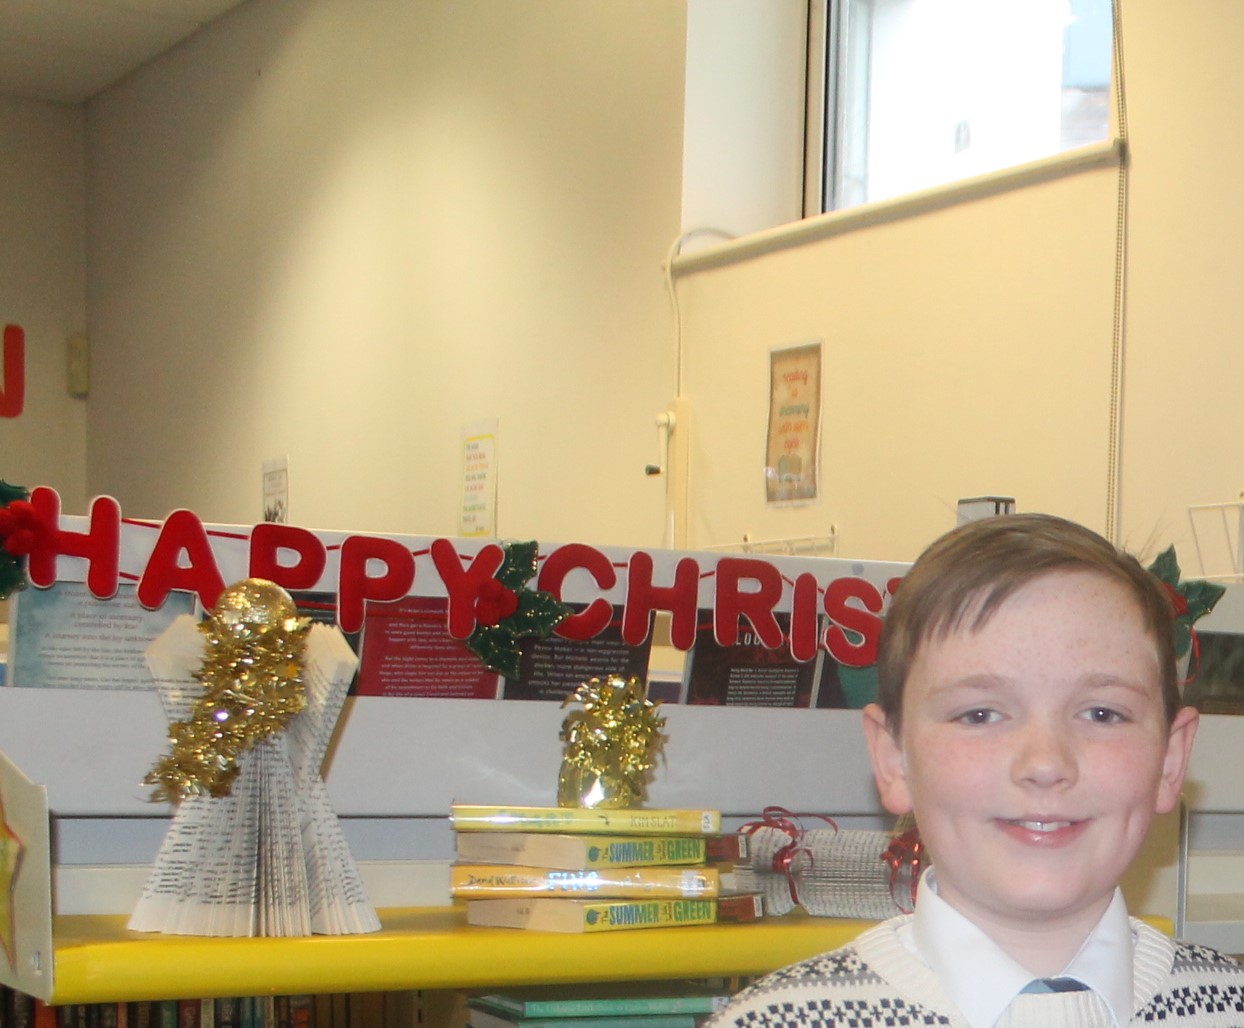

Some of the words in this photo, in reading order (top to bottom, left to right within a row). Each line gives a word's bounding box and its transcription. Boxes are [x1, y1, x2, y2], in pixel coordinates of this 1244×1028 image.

[28, 486, 505, 639] HAPPY
[537, 542, 903, 667] CHRIS
[650, 815, 677, 829] SLAT
[609, 841, 654, 863] SUMMER
[667, 839, 701, 860] GREEN
[609, 902, 660, 926] SUMMER
[673, 901, 712, 922] GREEN
